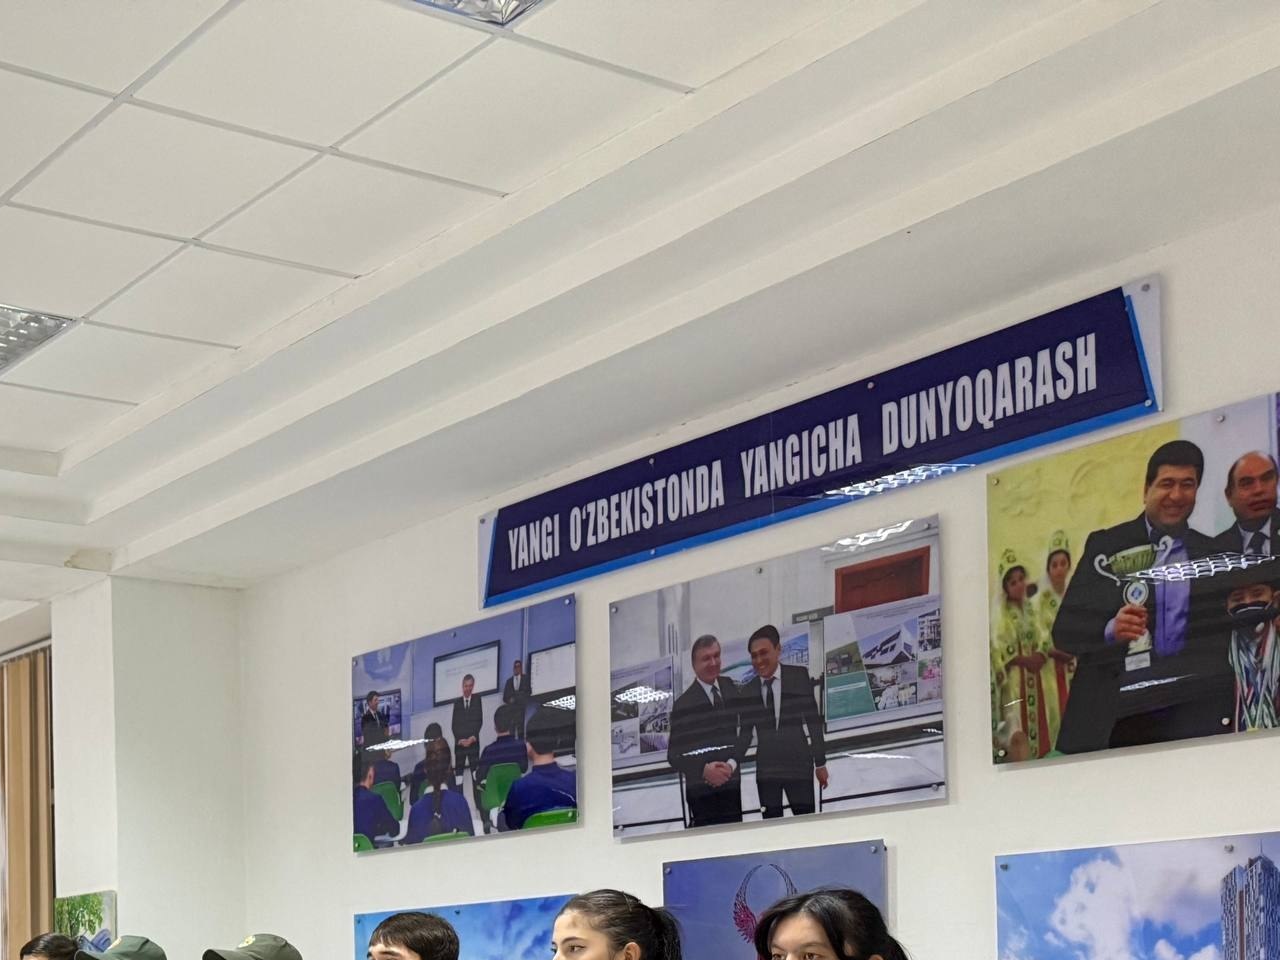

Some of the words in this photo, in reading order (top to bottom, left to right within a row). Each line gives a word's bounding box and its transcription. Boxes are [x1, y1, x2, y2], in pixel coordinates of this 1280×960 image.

[508, 514, 560, 571] YANGI
[740, 414, 863, 498] YANGICHA
[882, 333, 1097, 456] DUNYOQARASH
